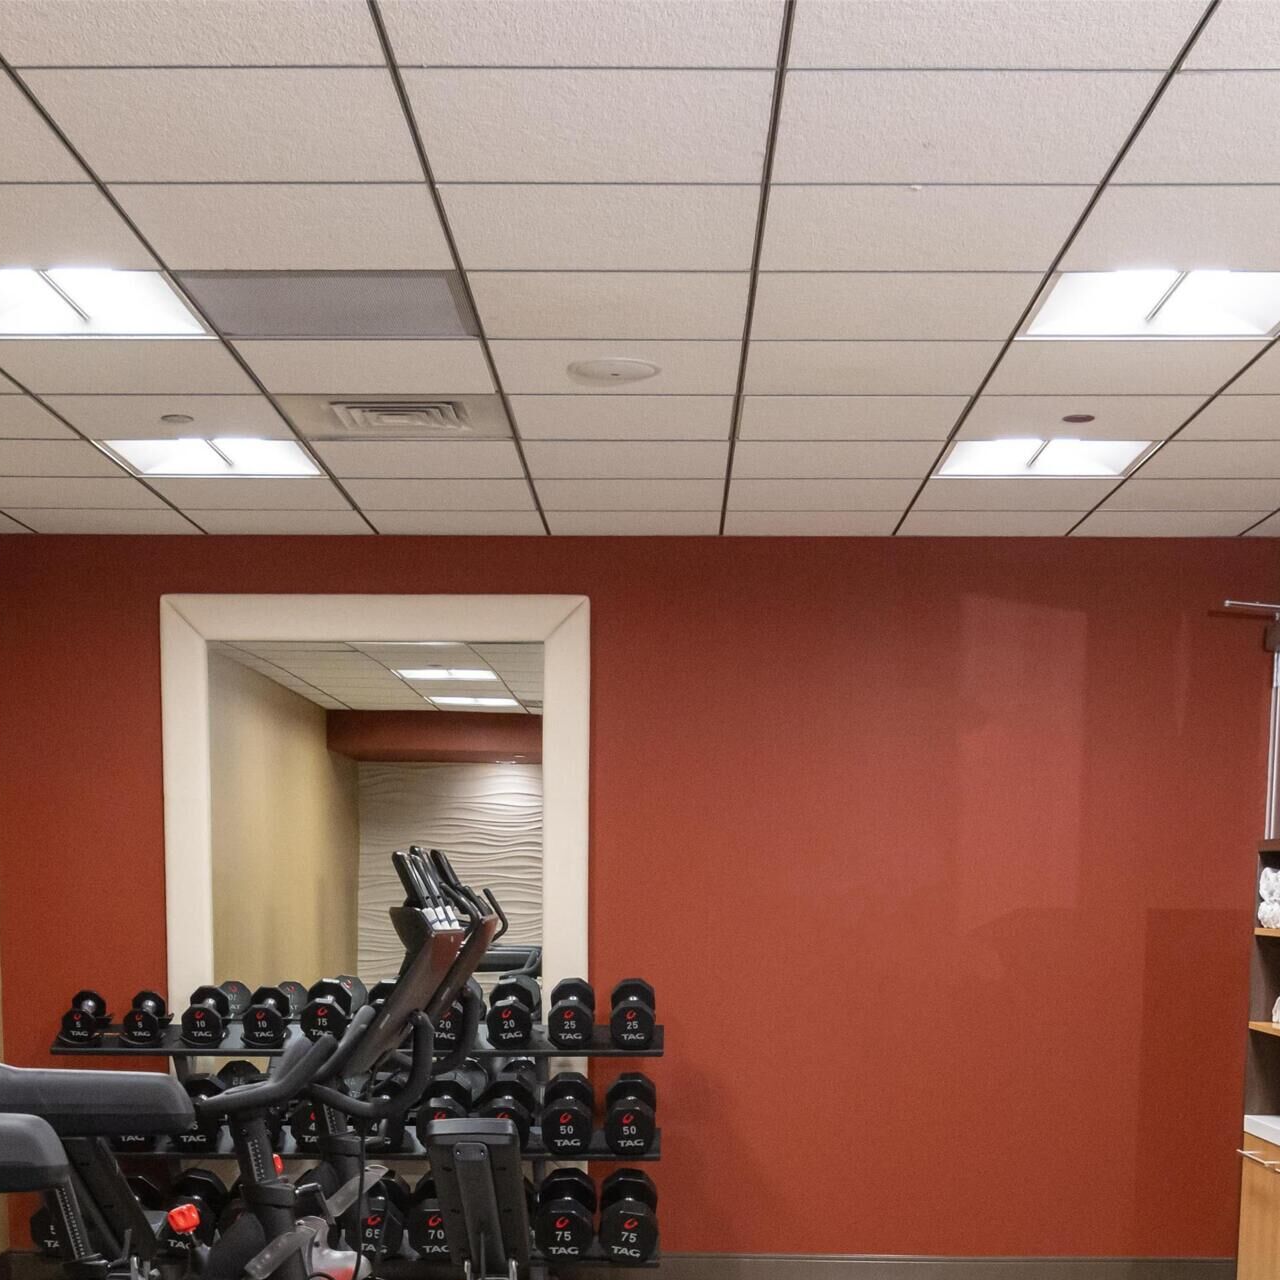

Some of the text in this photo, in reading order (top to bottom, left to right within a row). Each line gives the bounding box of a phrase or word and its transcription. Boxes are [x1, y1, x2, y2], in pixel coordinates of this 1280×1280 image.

[196, 1020, 206, 1028] 10
[257, 1020, 267, 1028] 10
[317, 1018, 328, 1026] 15
[439, 1019, 452, 1029] 20
[503, 1019, 516, 1029] 20
[564, 1021, 577, 1029] 25
[626, 1021, 639, 1030] 25
[434, 1031, 456, 1040] TAG
[500, 1031, 523, 1040] TAG
[559, 1032, 582, 1040] TAG
[622, 1033, 645, 1041] TAG
[560, 1126, 574, 1135] 50
[622, 1126, 637, 1136] 50
[180, 1135, 207, 1143] TAG
[554, 1139, 581, 1147] TAG
[618, 1140, 644, 1148] TAG
[365, 1228, 382, 1239] 65
[428, 1230, 445, 1240] 70
[556, 1231, 572, 1241] 75
[621, 1231, 638, 1243] 75
[549, 1246, 579, 1255] TAG
[611, 1245, 641, 1258] TAG
